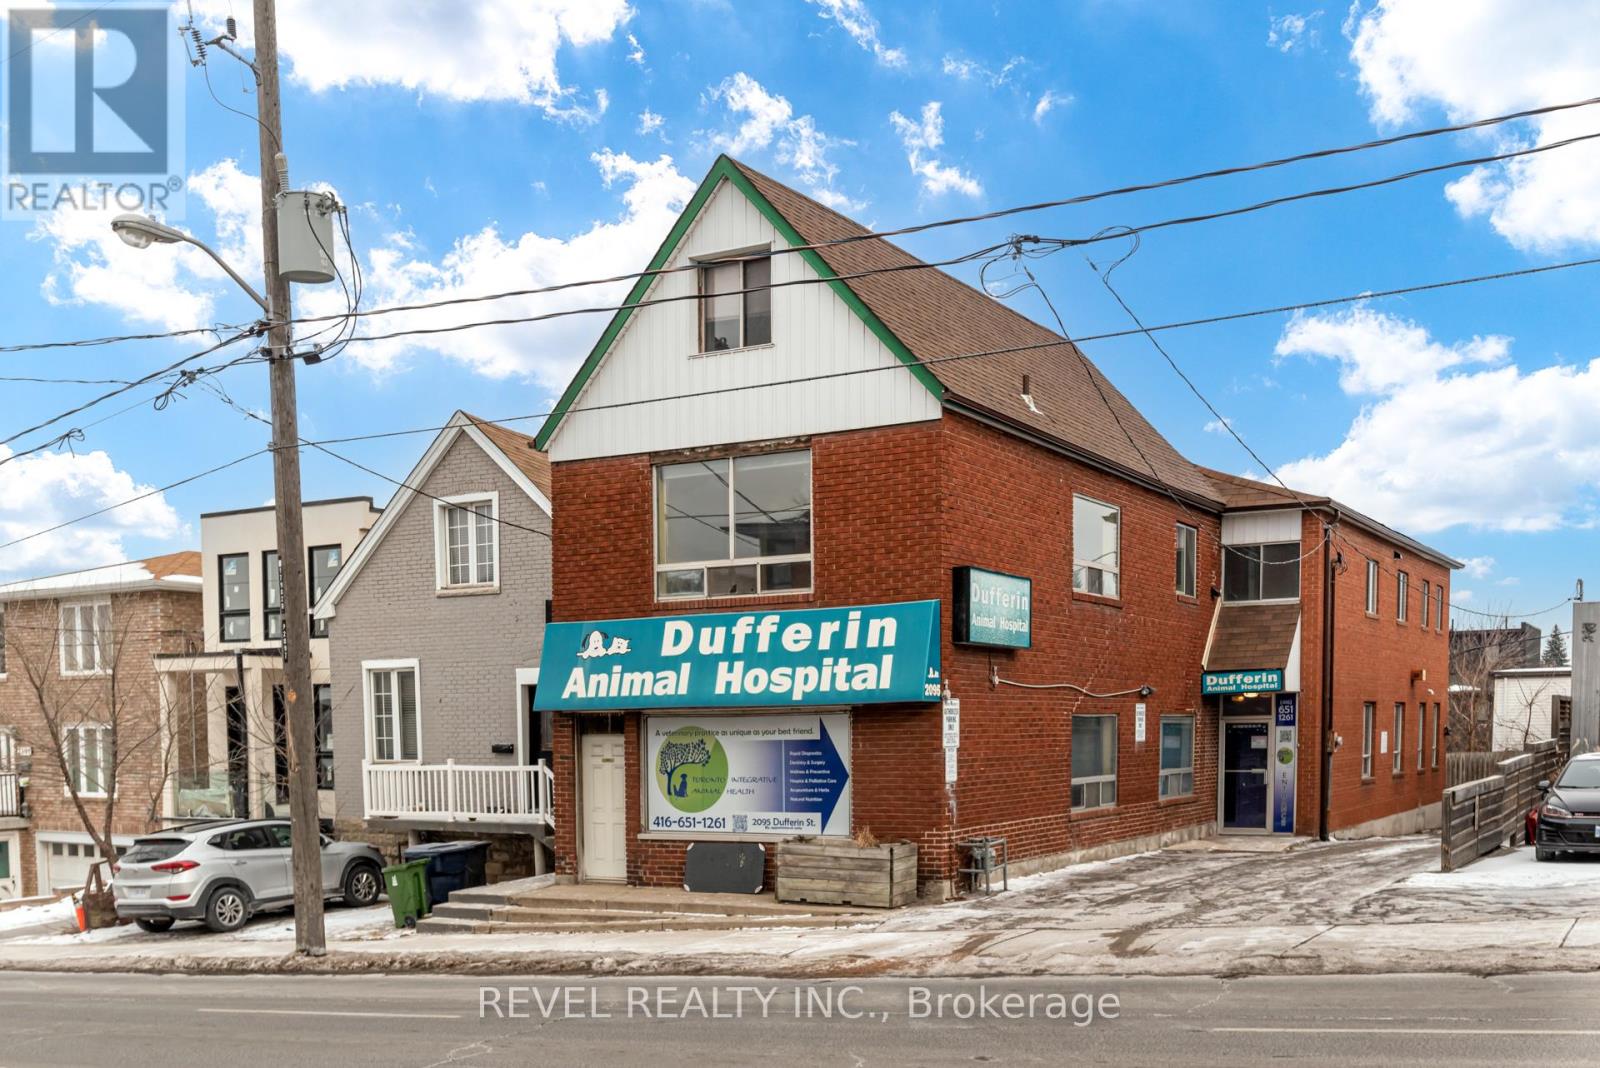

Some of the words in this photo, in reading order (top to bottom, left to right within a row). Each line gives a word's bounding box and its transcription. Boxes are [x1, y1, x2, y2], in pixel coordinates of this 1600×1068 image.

[971, 583, 1028, 610] Dufferin
[972, 613, 996, 629] Animal
[1000, 616, 1028, 634] Hospital
[661, 611, 898, 656] Dufferin
[562, 662, 691, 699] Animal
[714, 654, 893, 700] Hospital
[1206, 672, 1278, 686] Dufferin
[1241, 682, 1278, 691] Hospital
[1278, 705, 1294, 714] 651
[729, 728, 752, 738] unique
[778, 727, 791, 735] best
[653, 816, 726, 829] 416-651-1261
[752, 818, 772, 826] 2095
[773, 817, 804, 827] Dufferin
[806, 817, 816, 827] St.
